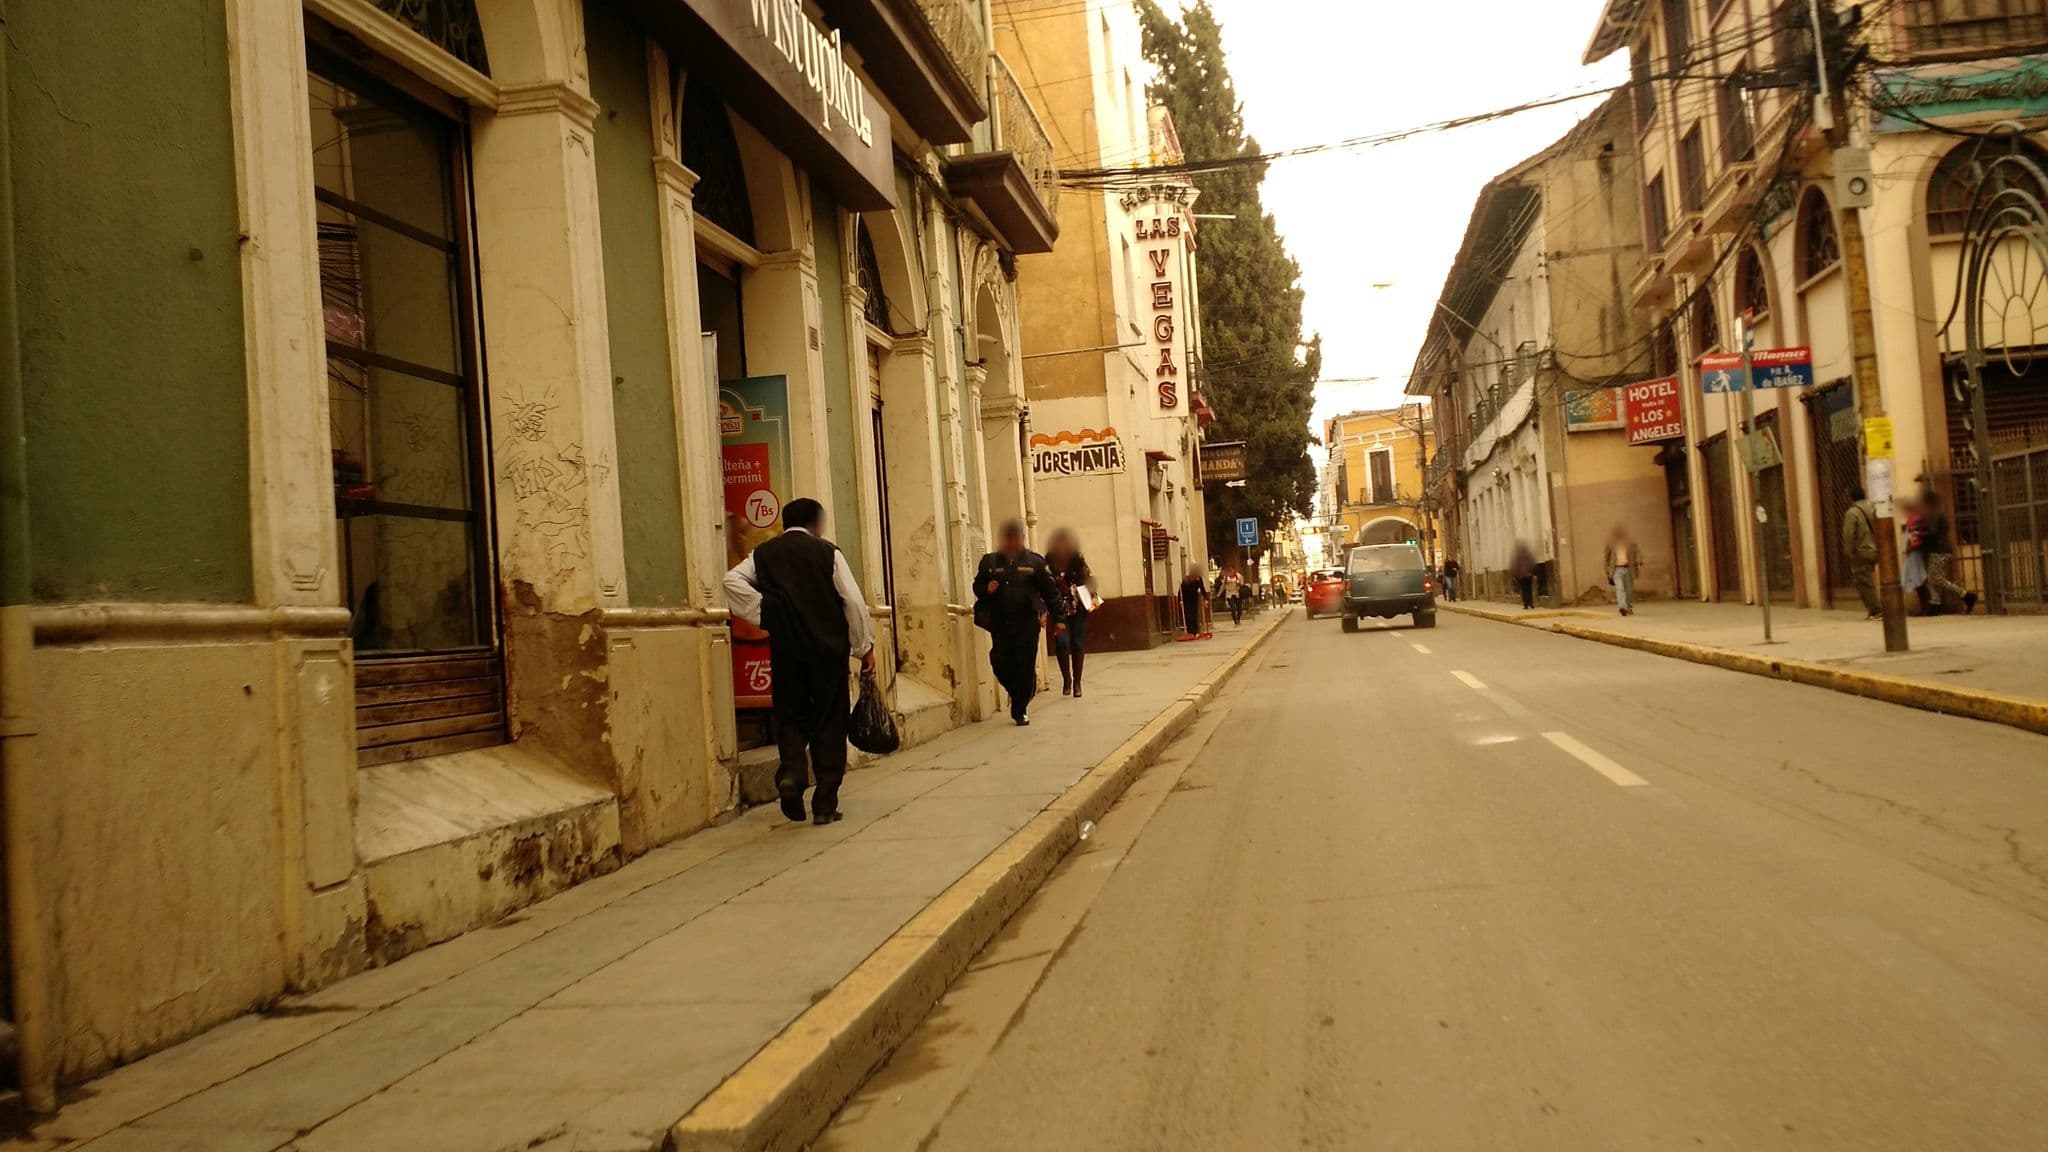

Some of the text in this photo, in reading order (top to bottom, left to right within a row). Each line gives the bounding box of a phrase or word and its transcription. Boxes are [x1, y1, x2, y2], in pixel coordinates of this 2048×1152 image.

[1120, 184, 1189, 212] HOTEL
[1136, 217, 1181, 239] LAS
[1149, 249, 1178, 409] VEGAS
[1629, 382, 1676, 402] HOTEL
[1641, 409, 1664, 424] LOS
[1632, 422, 1681, 442] ANGELES
[744, 659, 772, 691] 75
